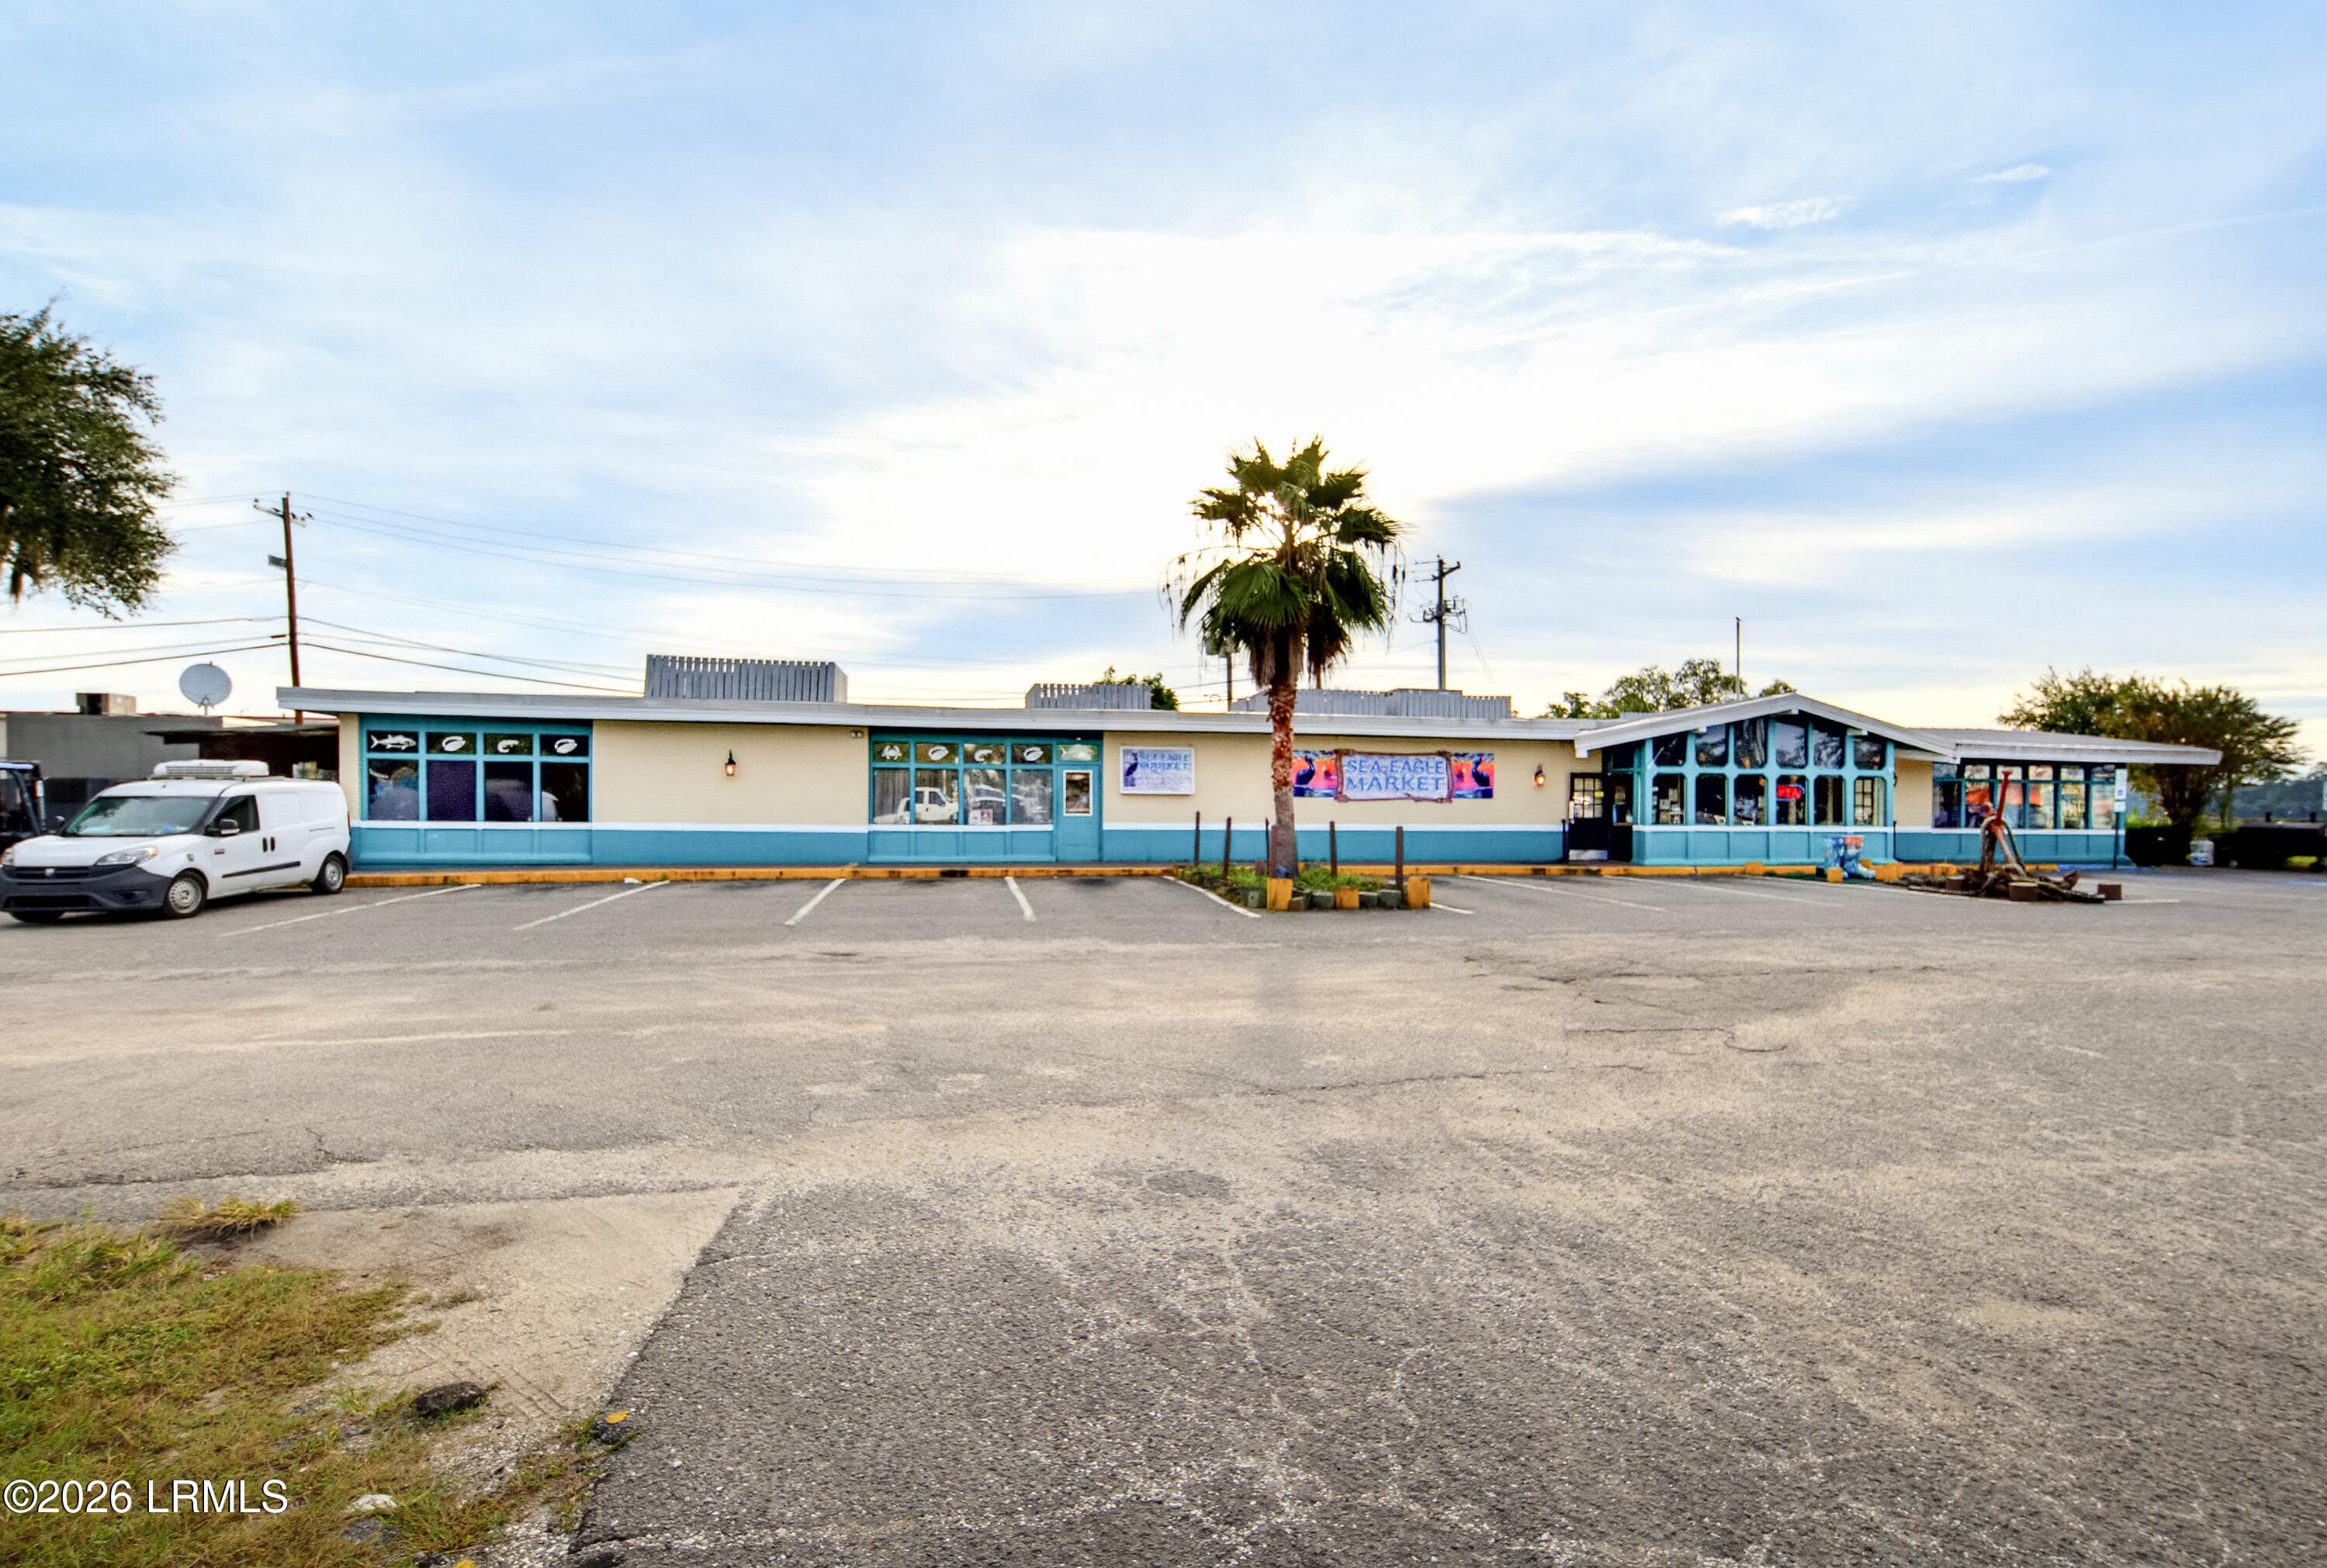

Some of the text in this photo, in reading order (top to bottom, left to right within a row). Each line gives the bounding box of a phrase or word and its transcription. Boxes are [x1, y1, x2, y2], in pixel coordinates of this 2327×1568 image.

[1346, 760, 1444, 774] SEA EAGLE
[1346, 776, 1444, 791] MARKET
